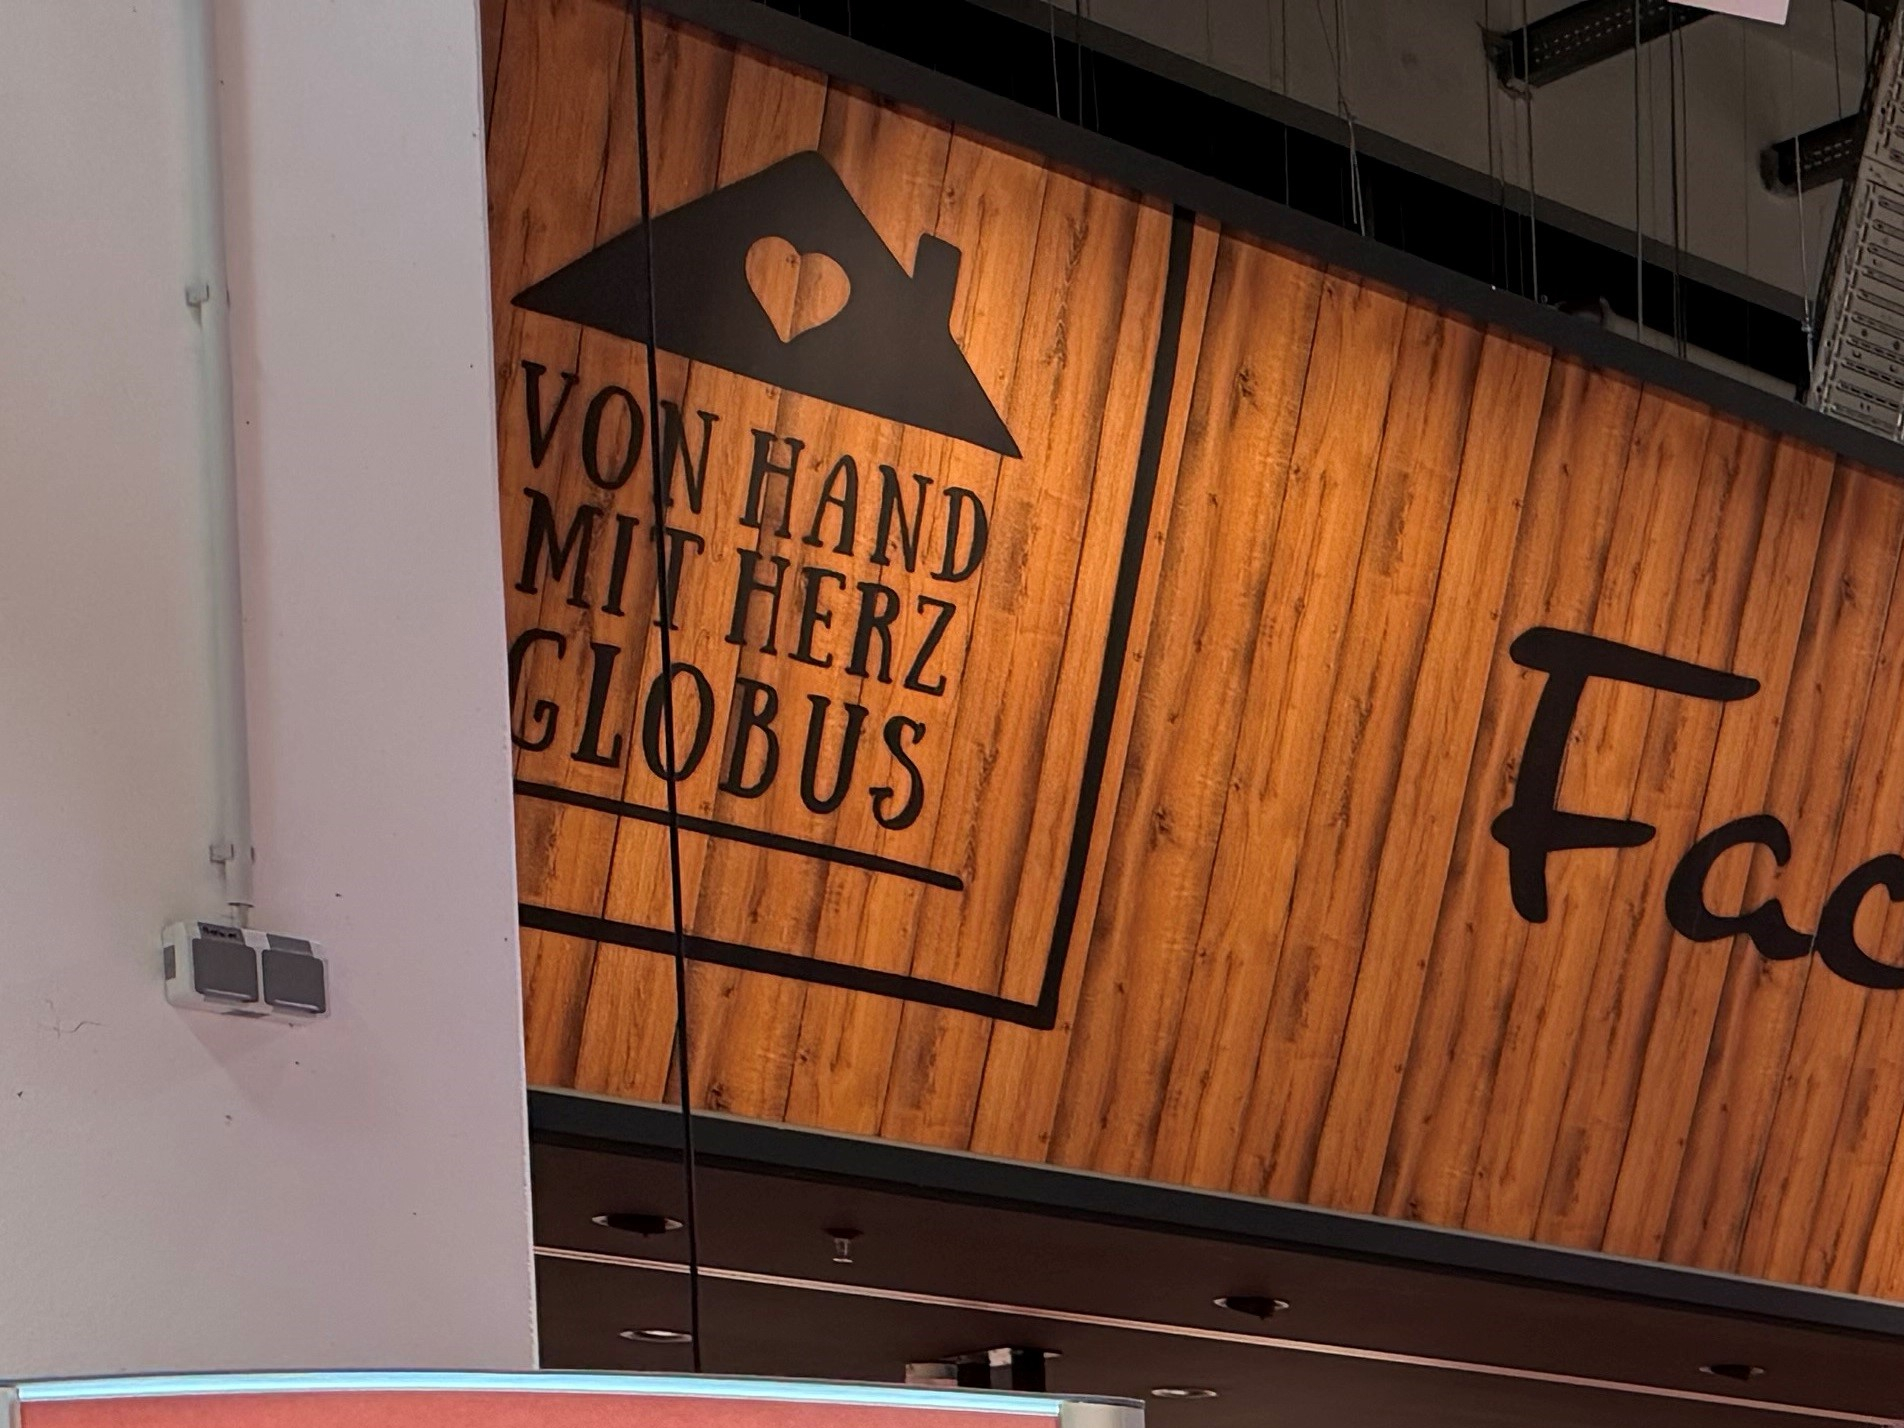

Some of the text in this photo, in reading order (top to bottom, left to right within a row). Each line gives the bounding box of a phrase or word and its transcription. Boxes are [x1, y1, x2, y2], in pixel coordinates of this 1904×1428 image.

[523, 360, 988, 581] VON HAND
[516, 488, 957, 697] MIT HERZ
[509, 630, 927, 830] GLOBUS
